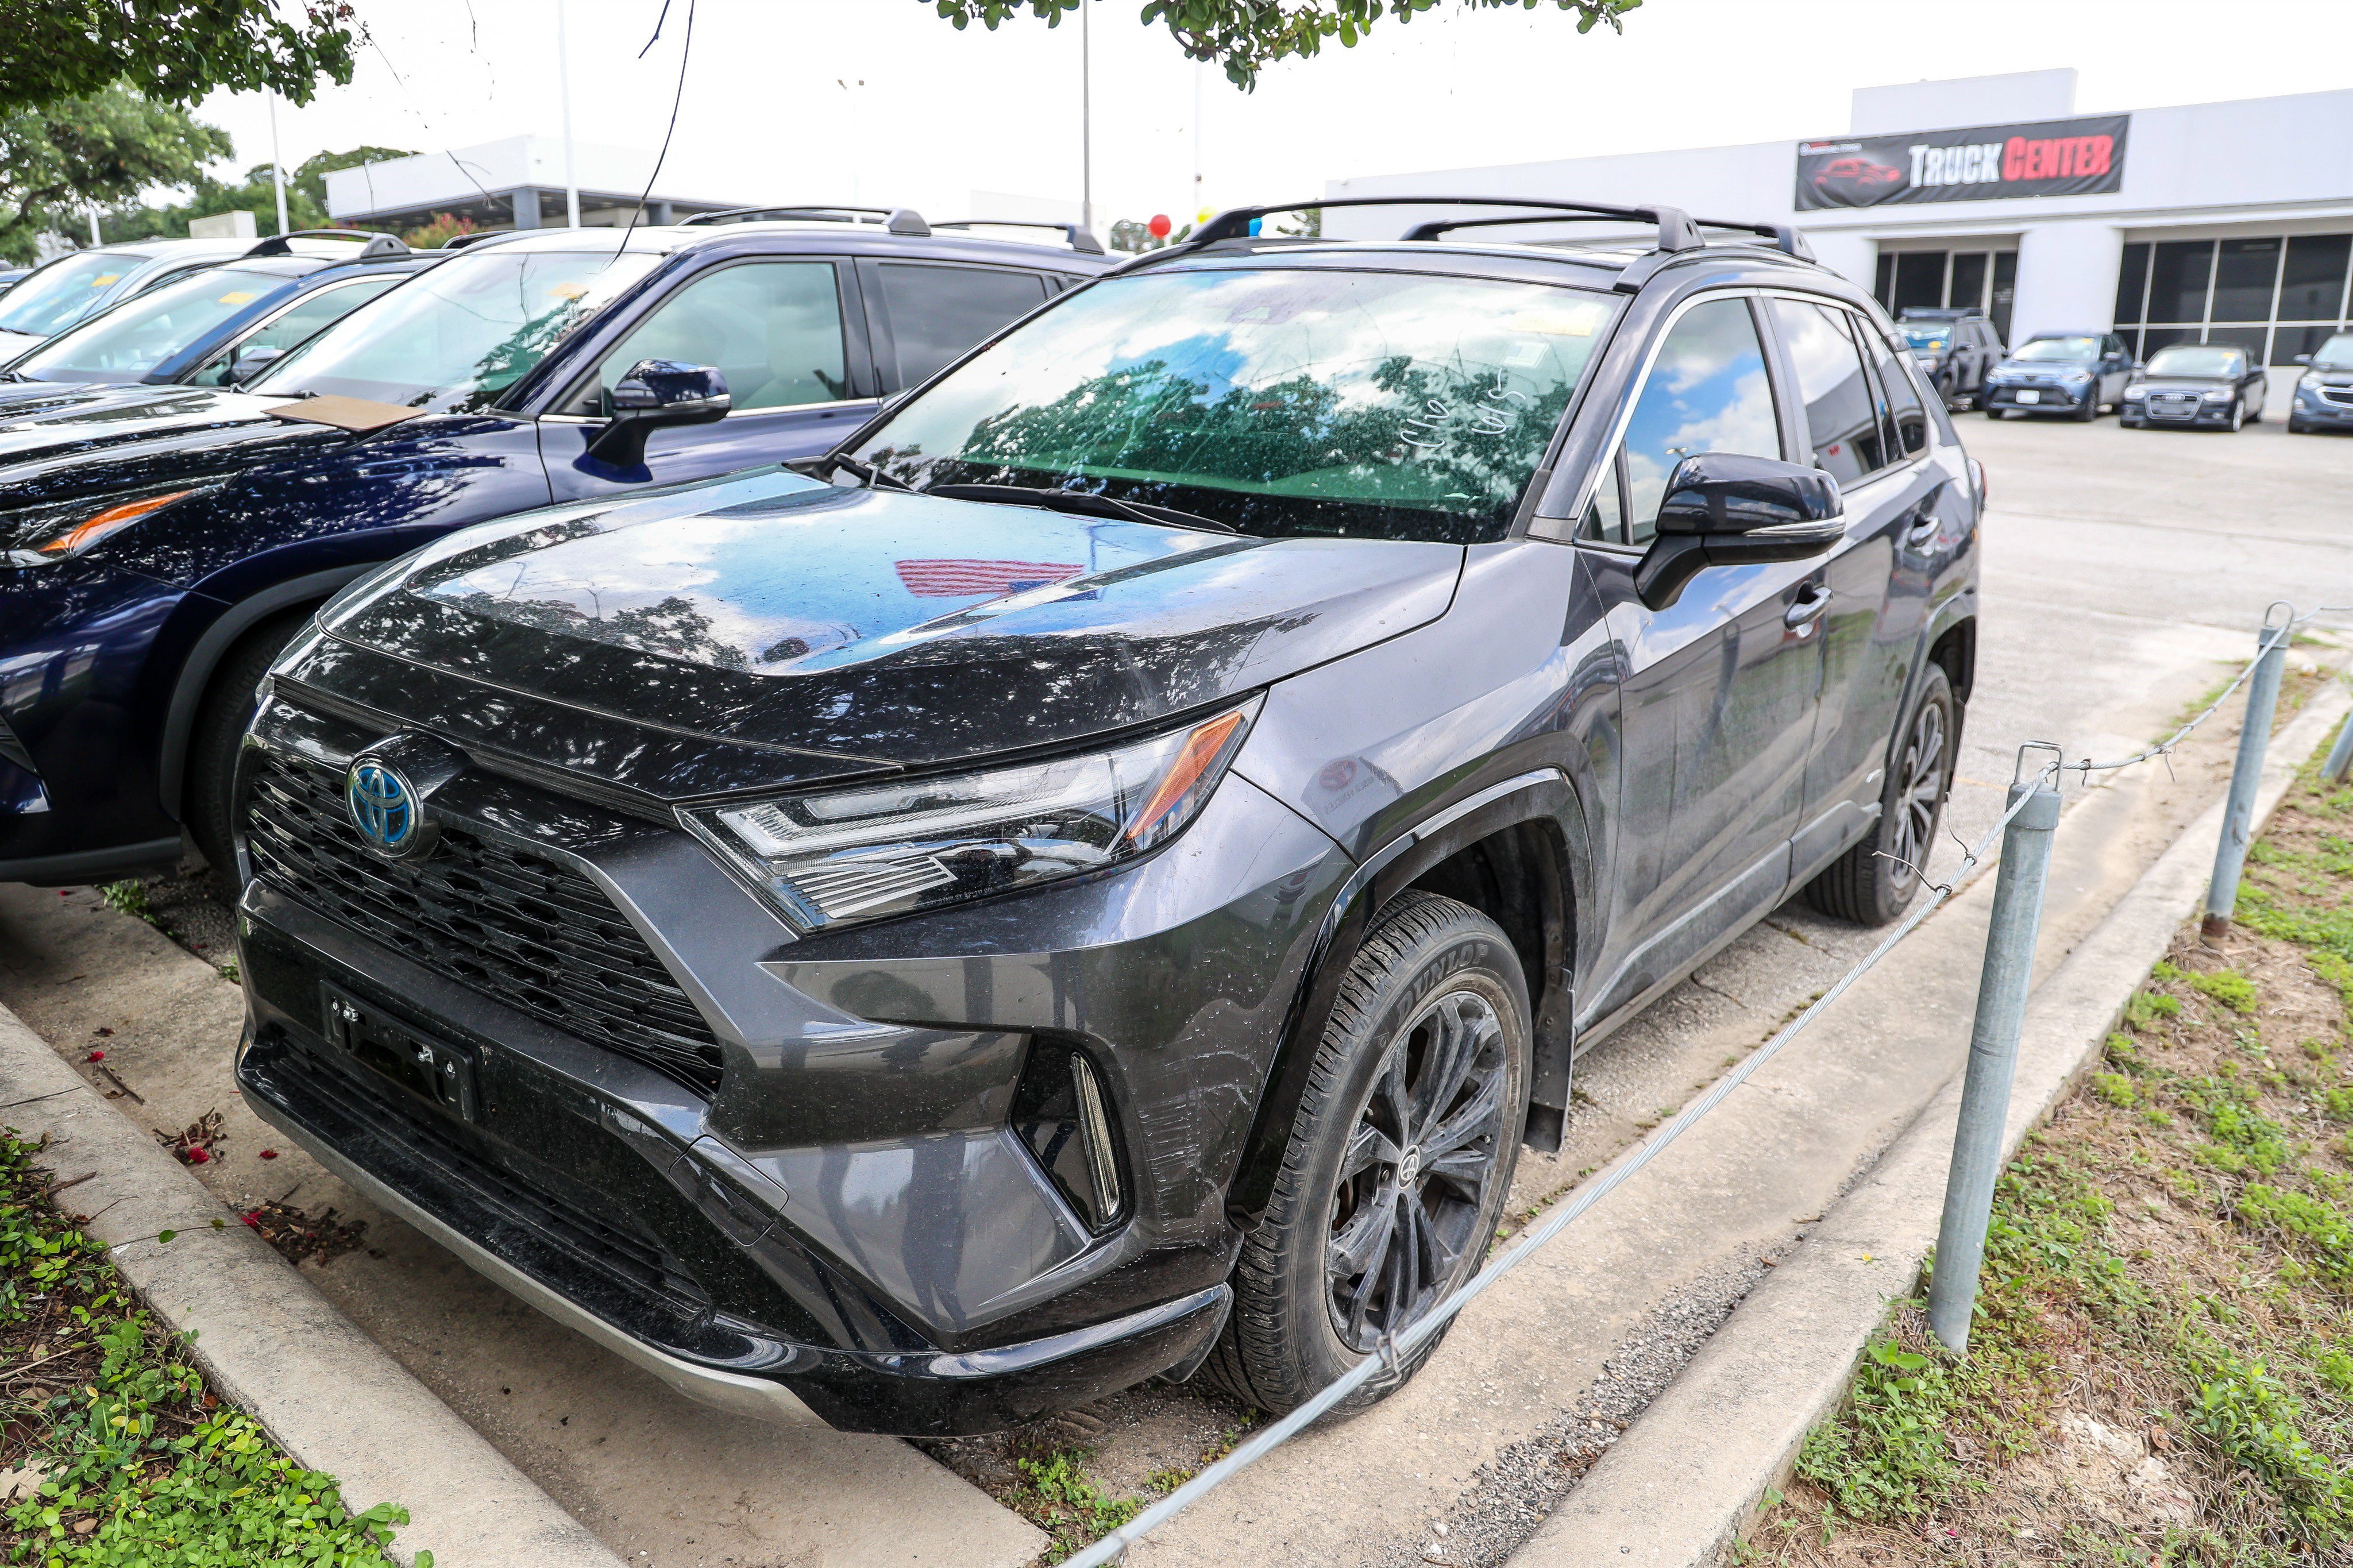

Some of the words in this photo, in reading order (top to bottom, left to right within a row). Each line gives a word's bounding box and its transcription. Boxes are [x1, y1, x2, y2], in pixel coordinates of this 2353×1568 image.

[1908, 143, 2003, 188] TRUCK
[2002, 135, 2113, 181] CENTER
[1397, 944, 1489, 1029] DUNLOP
